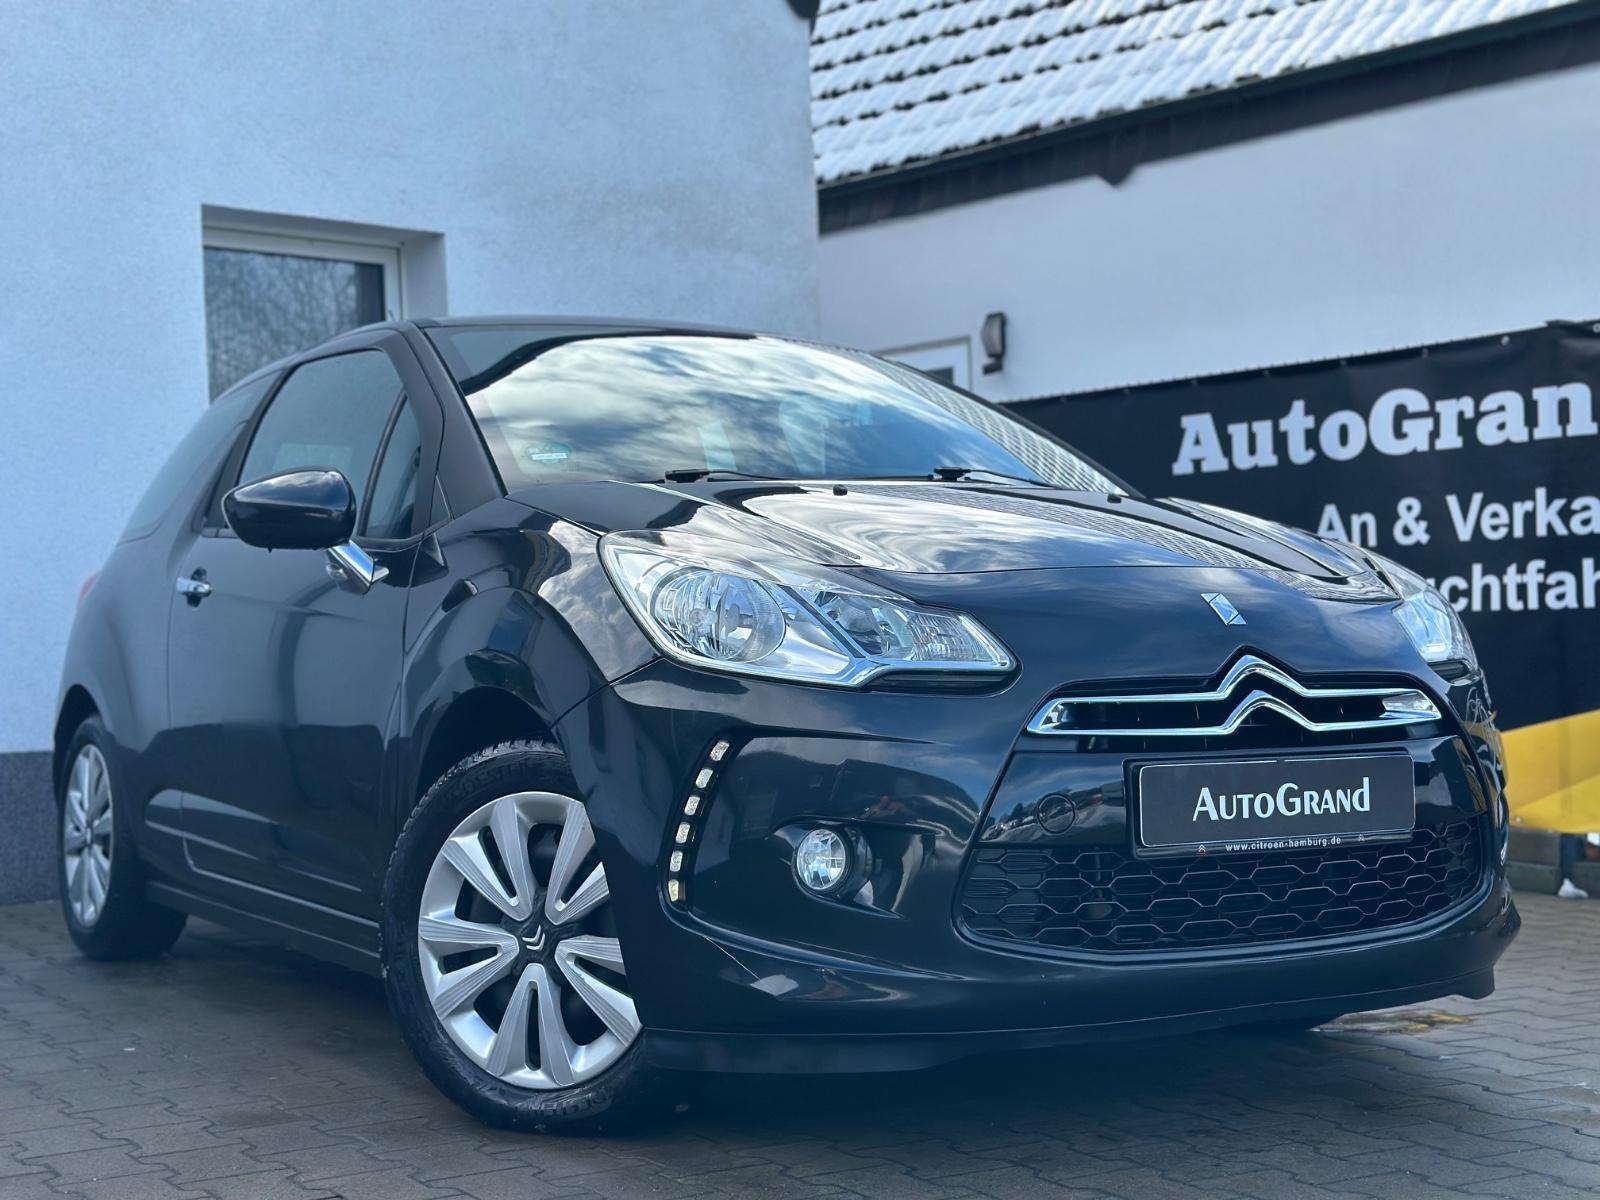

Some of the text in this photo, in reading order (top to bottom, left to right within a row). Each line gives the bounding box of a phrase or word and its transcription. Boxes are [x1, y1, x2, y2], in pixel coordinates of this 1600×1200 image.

[1172, 382, 1599, 475] AutoGran
[1318, 503, 1378, 548] An
[1392, 497, 1431, 546] &
[1425, 557, 1600, 613] chtfah
[1225, 836, 1342, 852] www.citroen-hamburg.de
